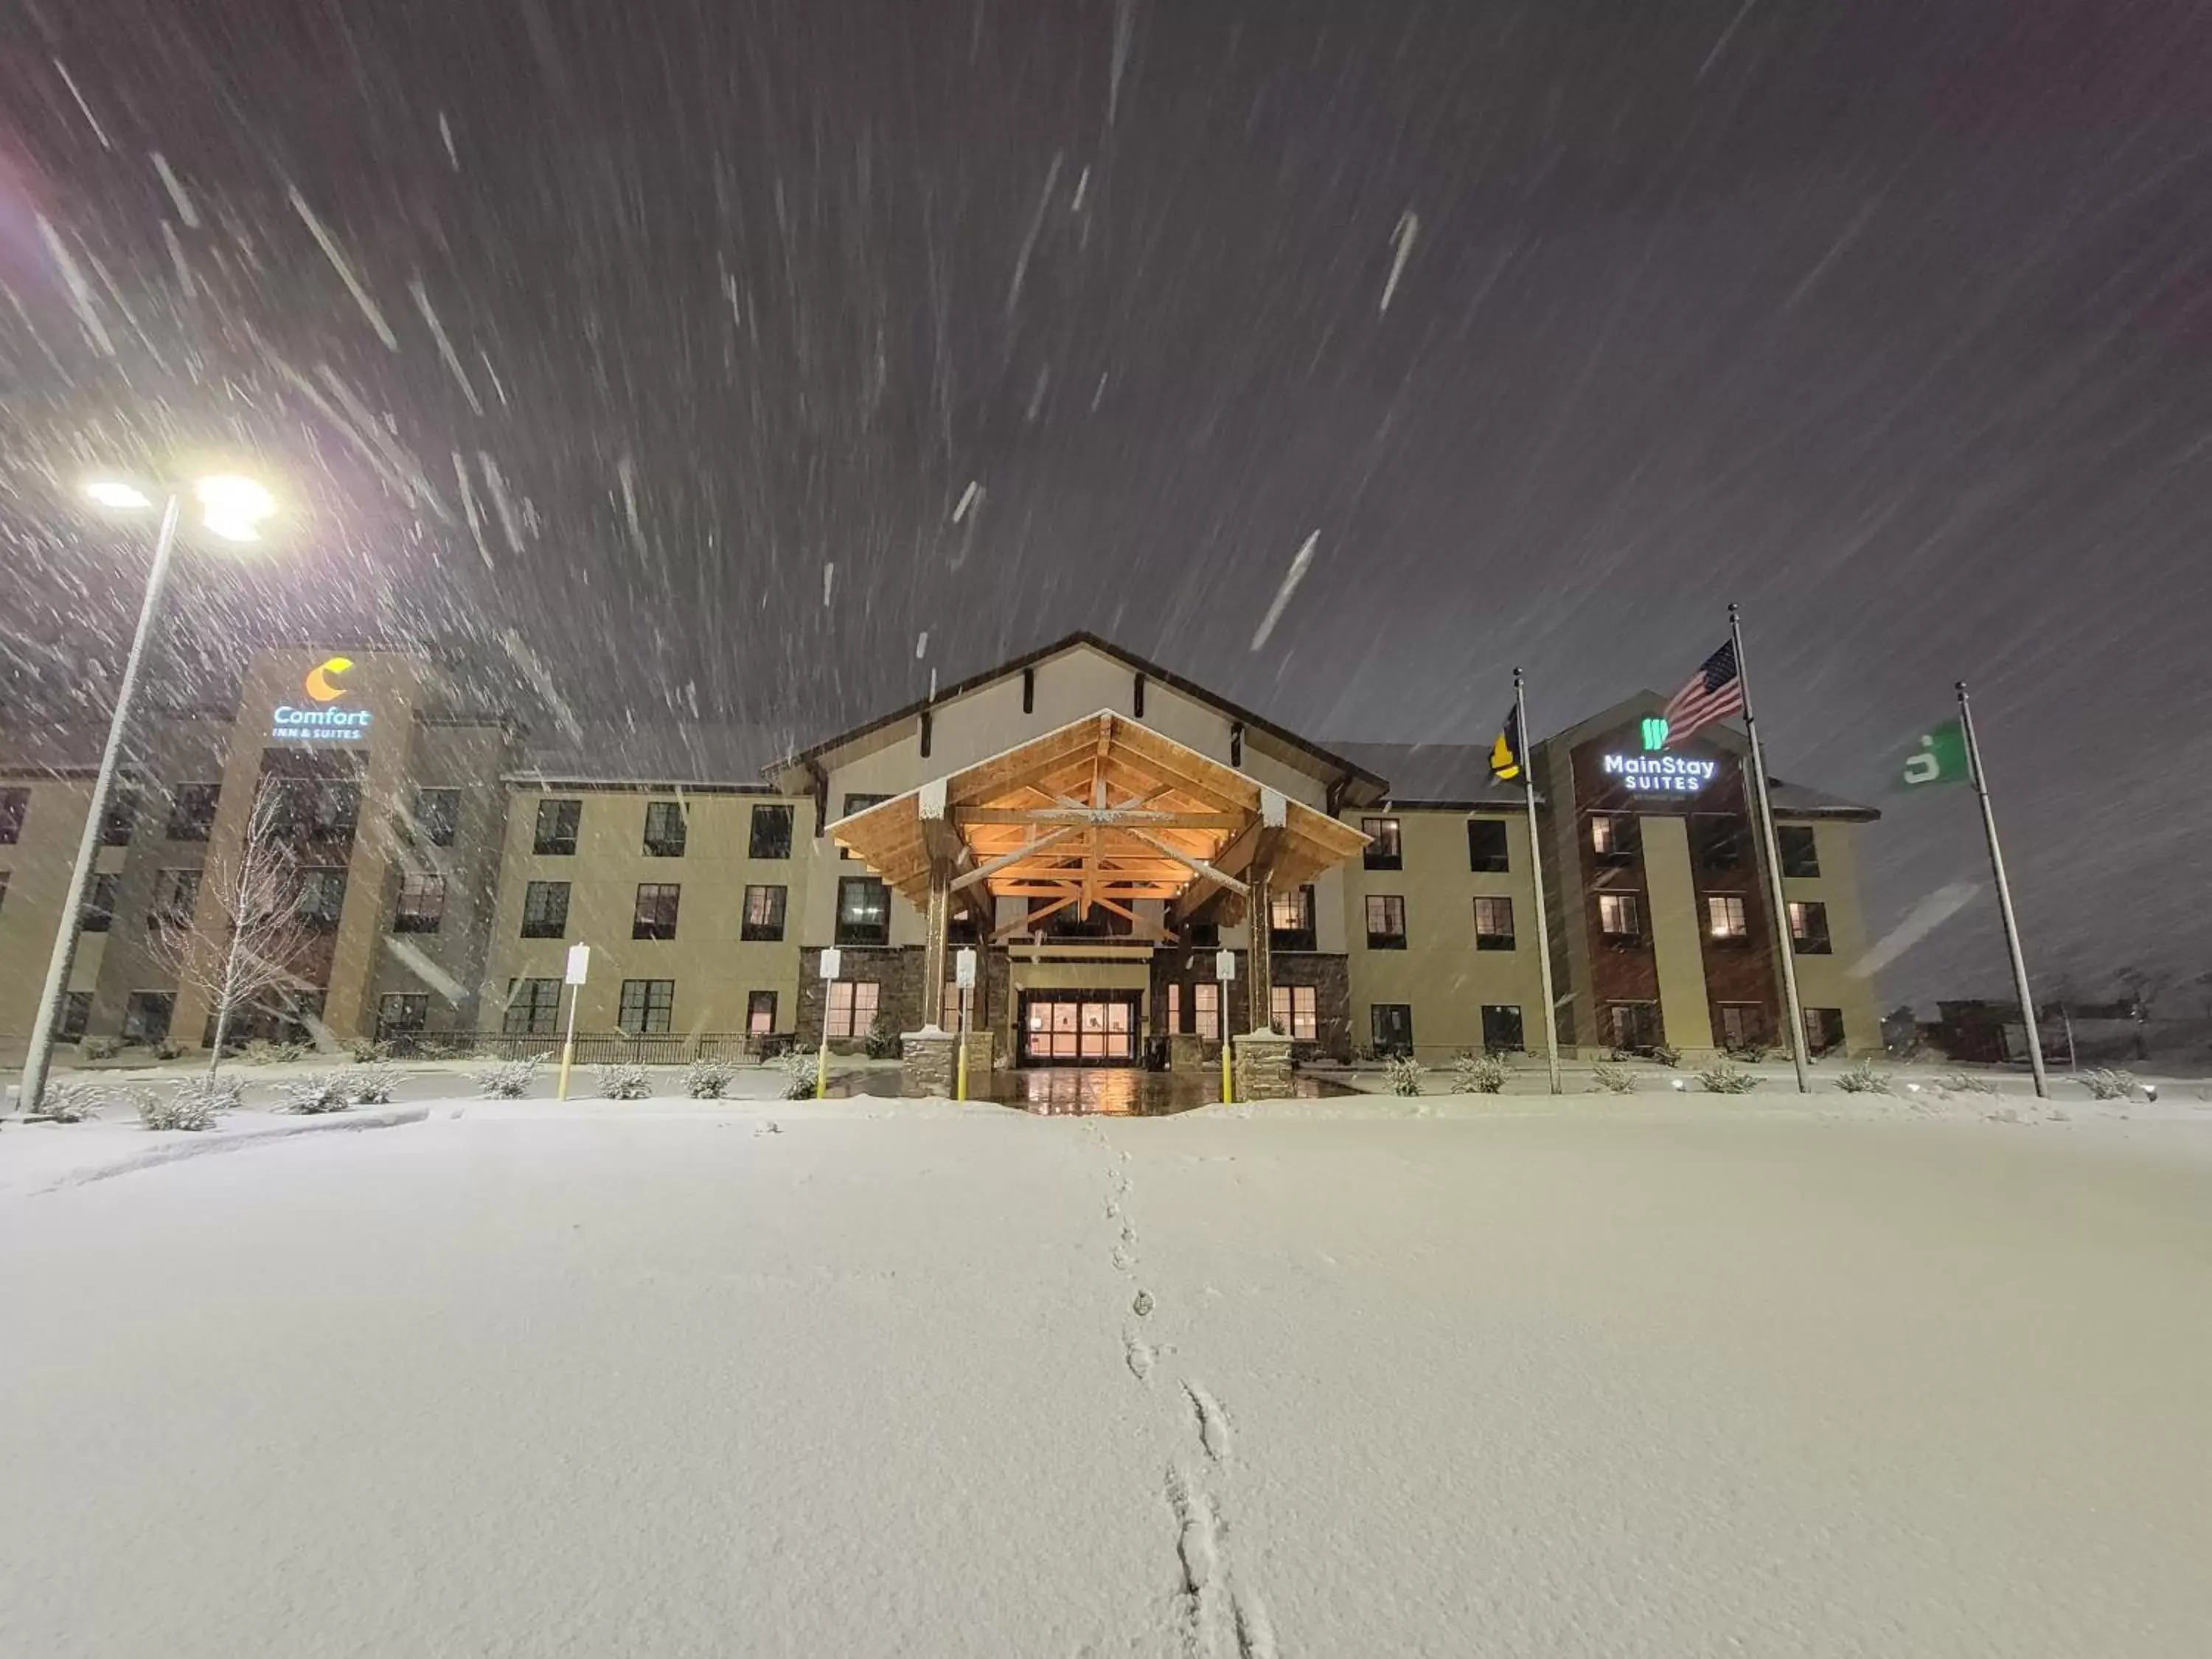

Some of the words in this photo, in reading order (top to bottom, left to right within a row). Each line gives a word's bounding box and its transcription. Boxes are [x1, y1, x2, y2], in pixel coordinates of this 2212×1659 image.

[274, 706, 372, 726] Comfort
[272, 727, 299, 738] INN
[300, 728, 310, 738] &
[313, 728, 361, 740] SUITES
[1604, 754, 1715, 779] MainStay
[1625, 776, 1700, 790] SUITES
